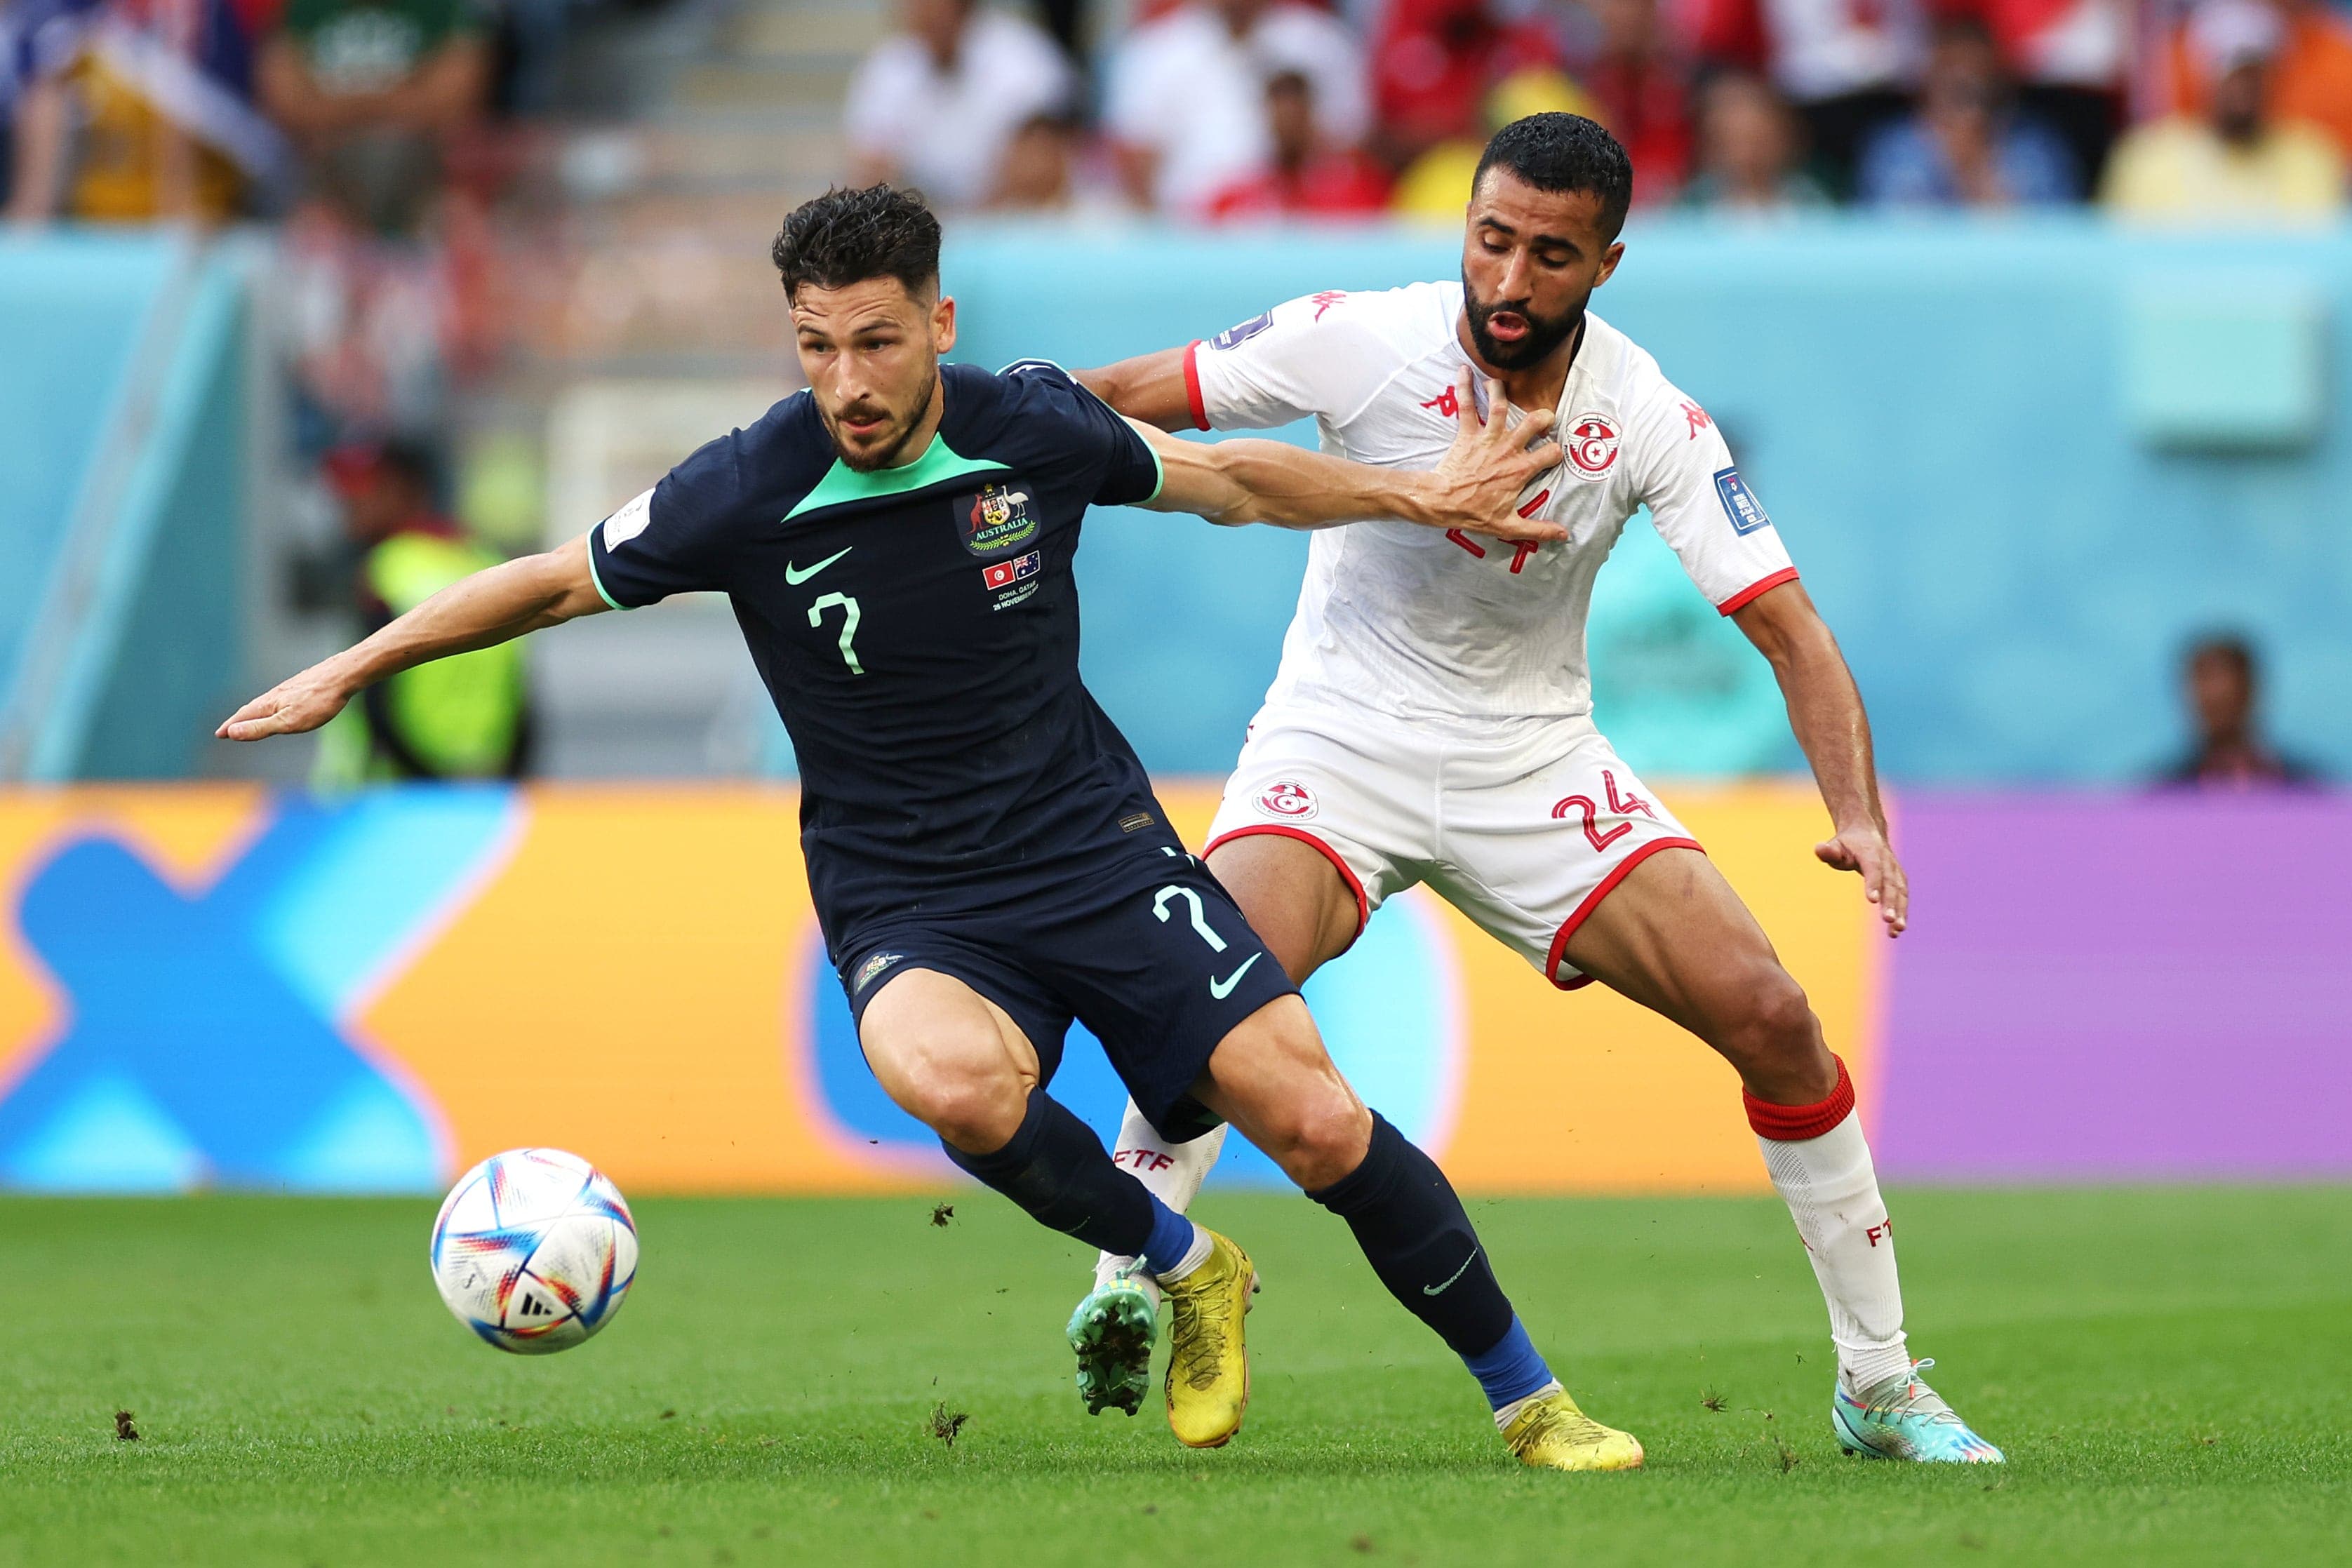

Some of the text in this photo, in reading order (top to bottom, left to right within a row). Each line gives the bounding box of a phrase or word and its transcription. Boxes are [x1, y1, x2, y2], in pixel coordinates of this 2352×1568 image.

[976, 517, 1028, 541] AUSTRALIA
[807, 591, 865, 675] 7
[1551, 770, 1659, 853] 24
[1152, 885, 1228, 953] 7
